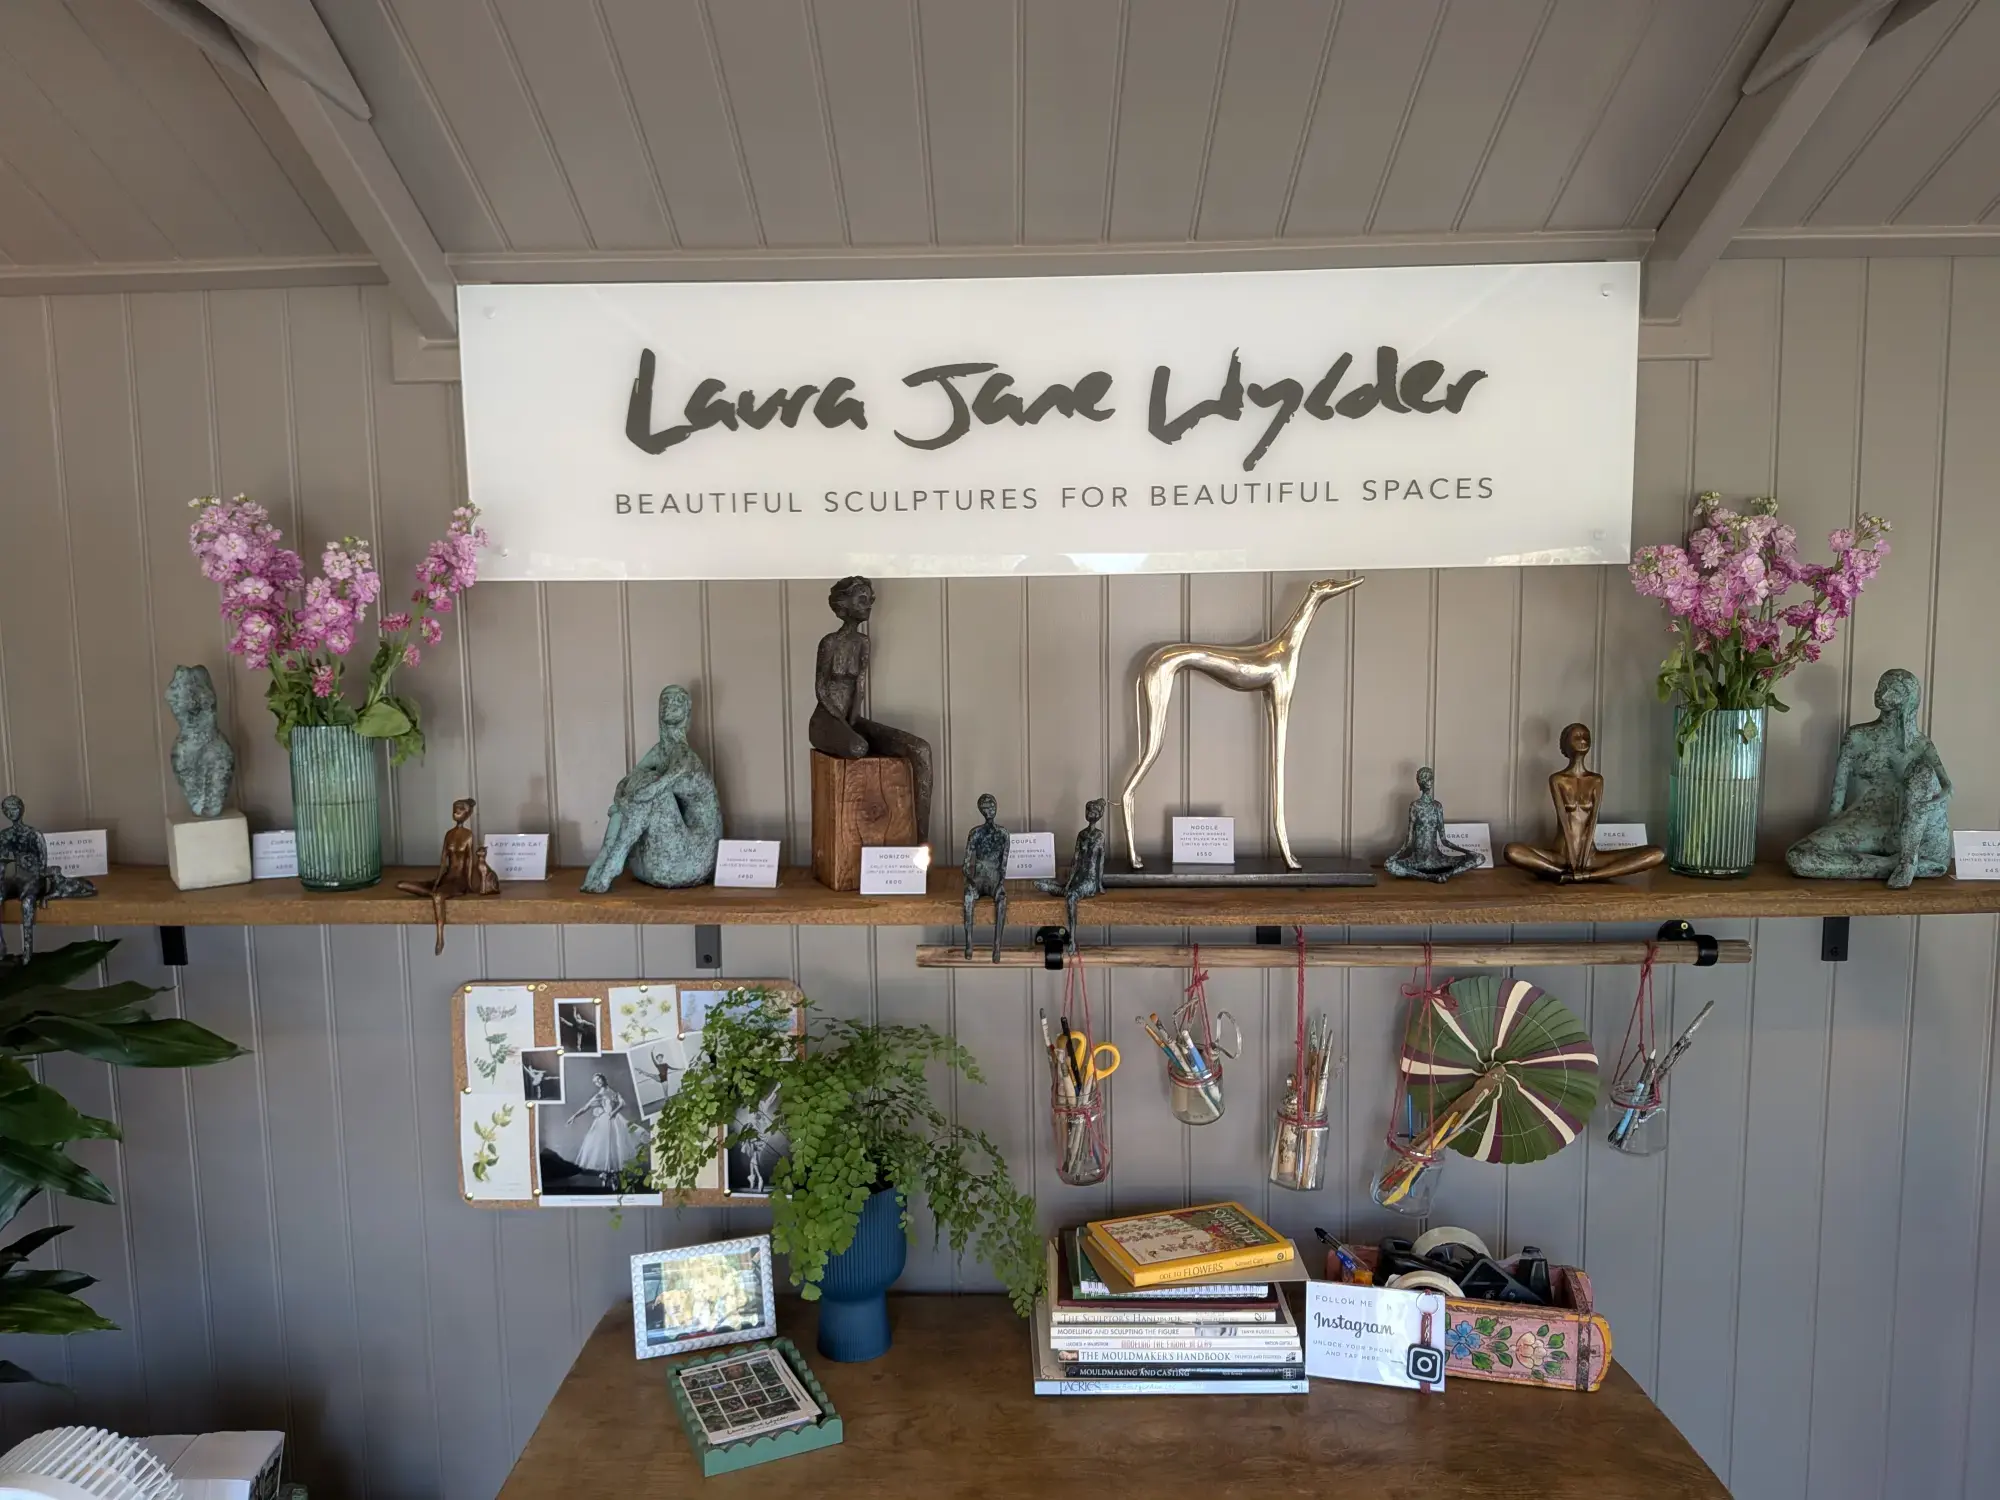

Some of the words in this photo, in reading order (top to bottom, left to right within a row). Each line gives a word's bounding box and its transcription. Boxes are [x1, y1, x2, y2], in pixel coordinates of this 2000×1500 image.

[625, 347, 868, 455] Laura
[893, 362, 1116, 451] Jane
[1148, 345, 1489, 472] Wylder
[615, 492, 803, 515] BEAUTIFUL
[823, 487, 1039, 513] SCULPTURES
[1061, 485, 1128, 509] FOR
[1150, 480, 1340, 507] BEAUTIFUL
[1362, 476, 1494, 502] SPACES
[1183, 1261, 1225, 1277] FLOWERS
[1315, 1294, 1356, 1306] FOLLOW
[1360, 1299, 1373, 1308] ME
[1313, 1311, 1395, 1339] Instagram
[1312, 1339, 1343, 1349] UNLOCK
[1345, 1343, 1367, 1351] YOUR
[1368, 1345, 1394, 1354] PHONE
[1081, 1351, 1099, 1360] THE
[1101, 1351, 1174, 1361] MOULDMAKER'S
[1176, 1351, 1232, 1361] HANDBOOK
[1079, 1368, 1138, 1376] MOULDMAKING
[1139, 1368, 1156, 1377] AND
[1156, 1368, 1190, 1377] CASTING
